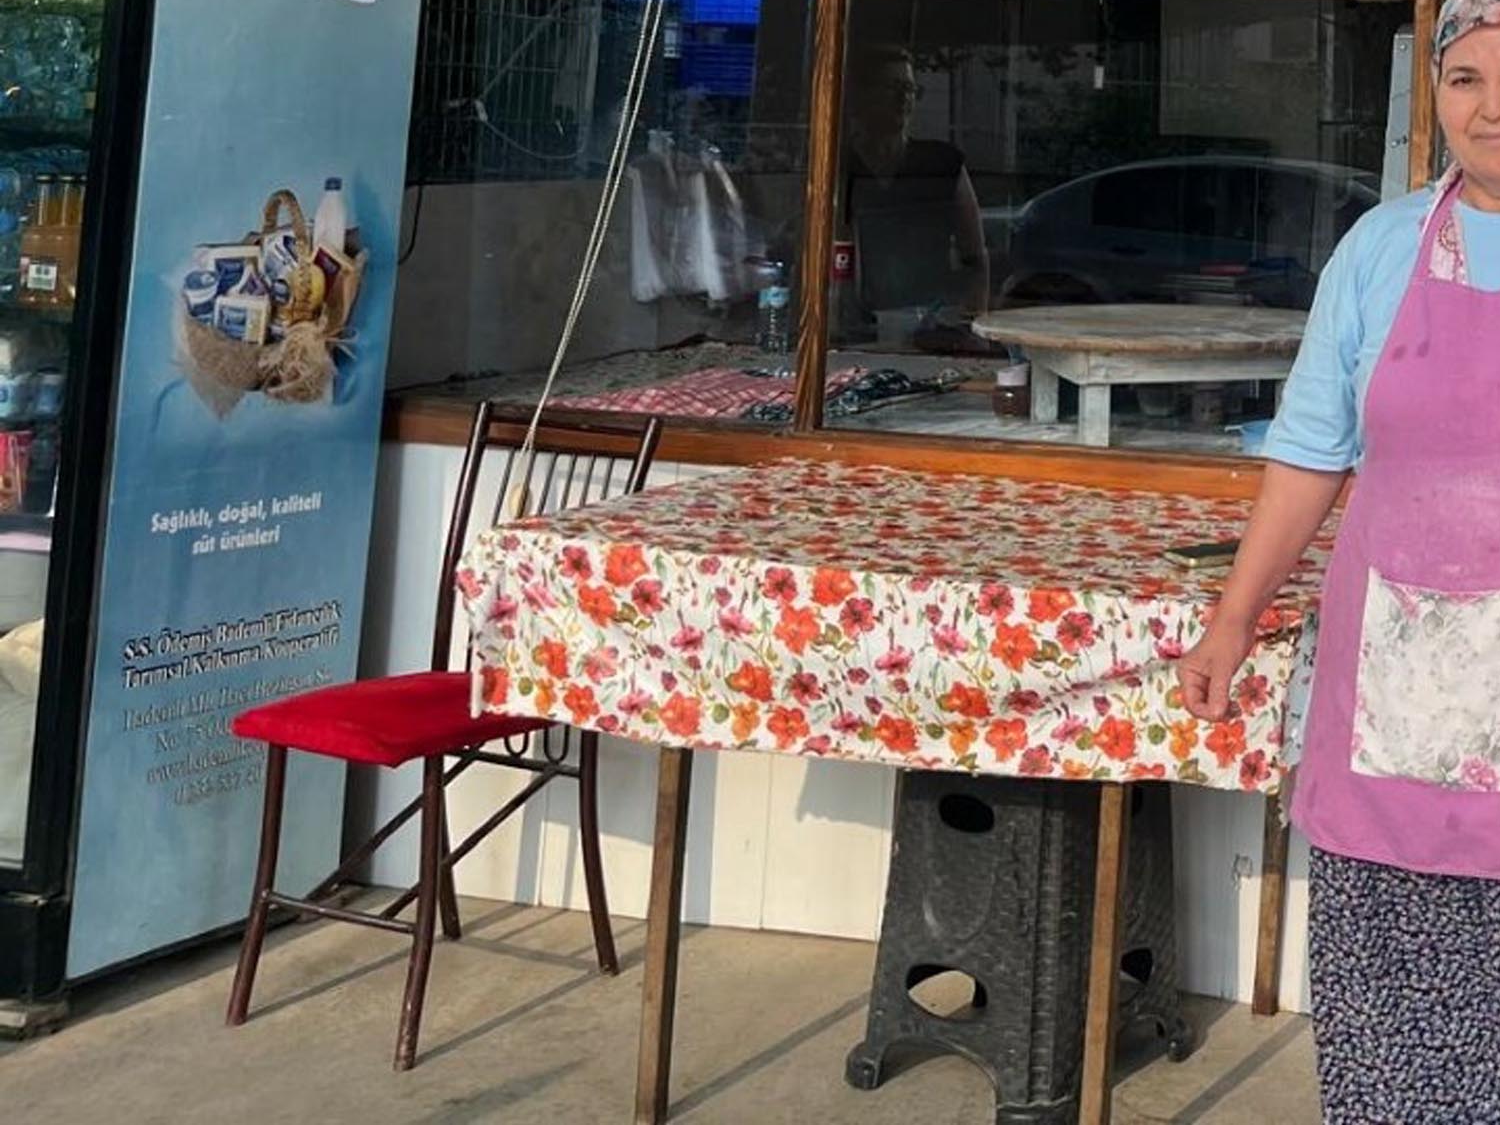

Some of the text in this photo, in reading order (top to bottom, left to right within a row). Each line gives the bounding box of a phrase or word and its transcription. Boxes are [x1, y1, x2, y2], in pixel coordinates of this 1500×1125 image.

[218, 498, 267, 524] doğal,
[271, 491, 323, 516] kaliteli
[192, 525, 281, 555] süt ürünleri
